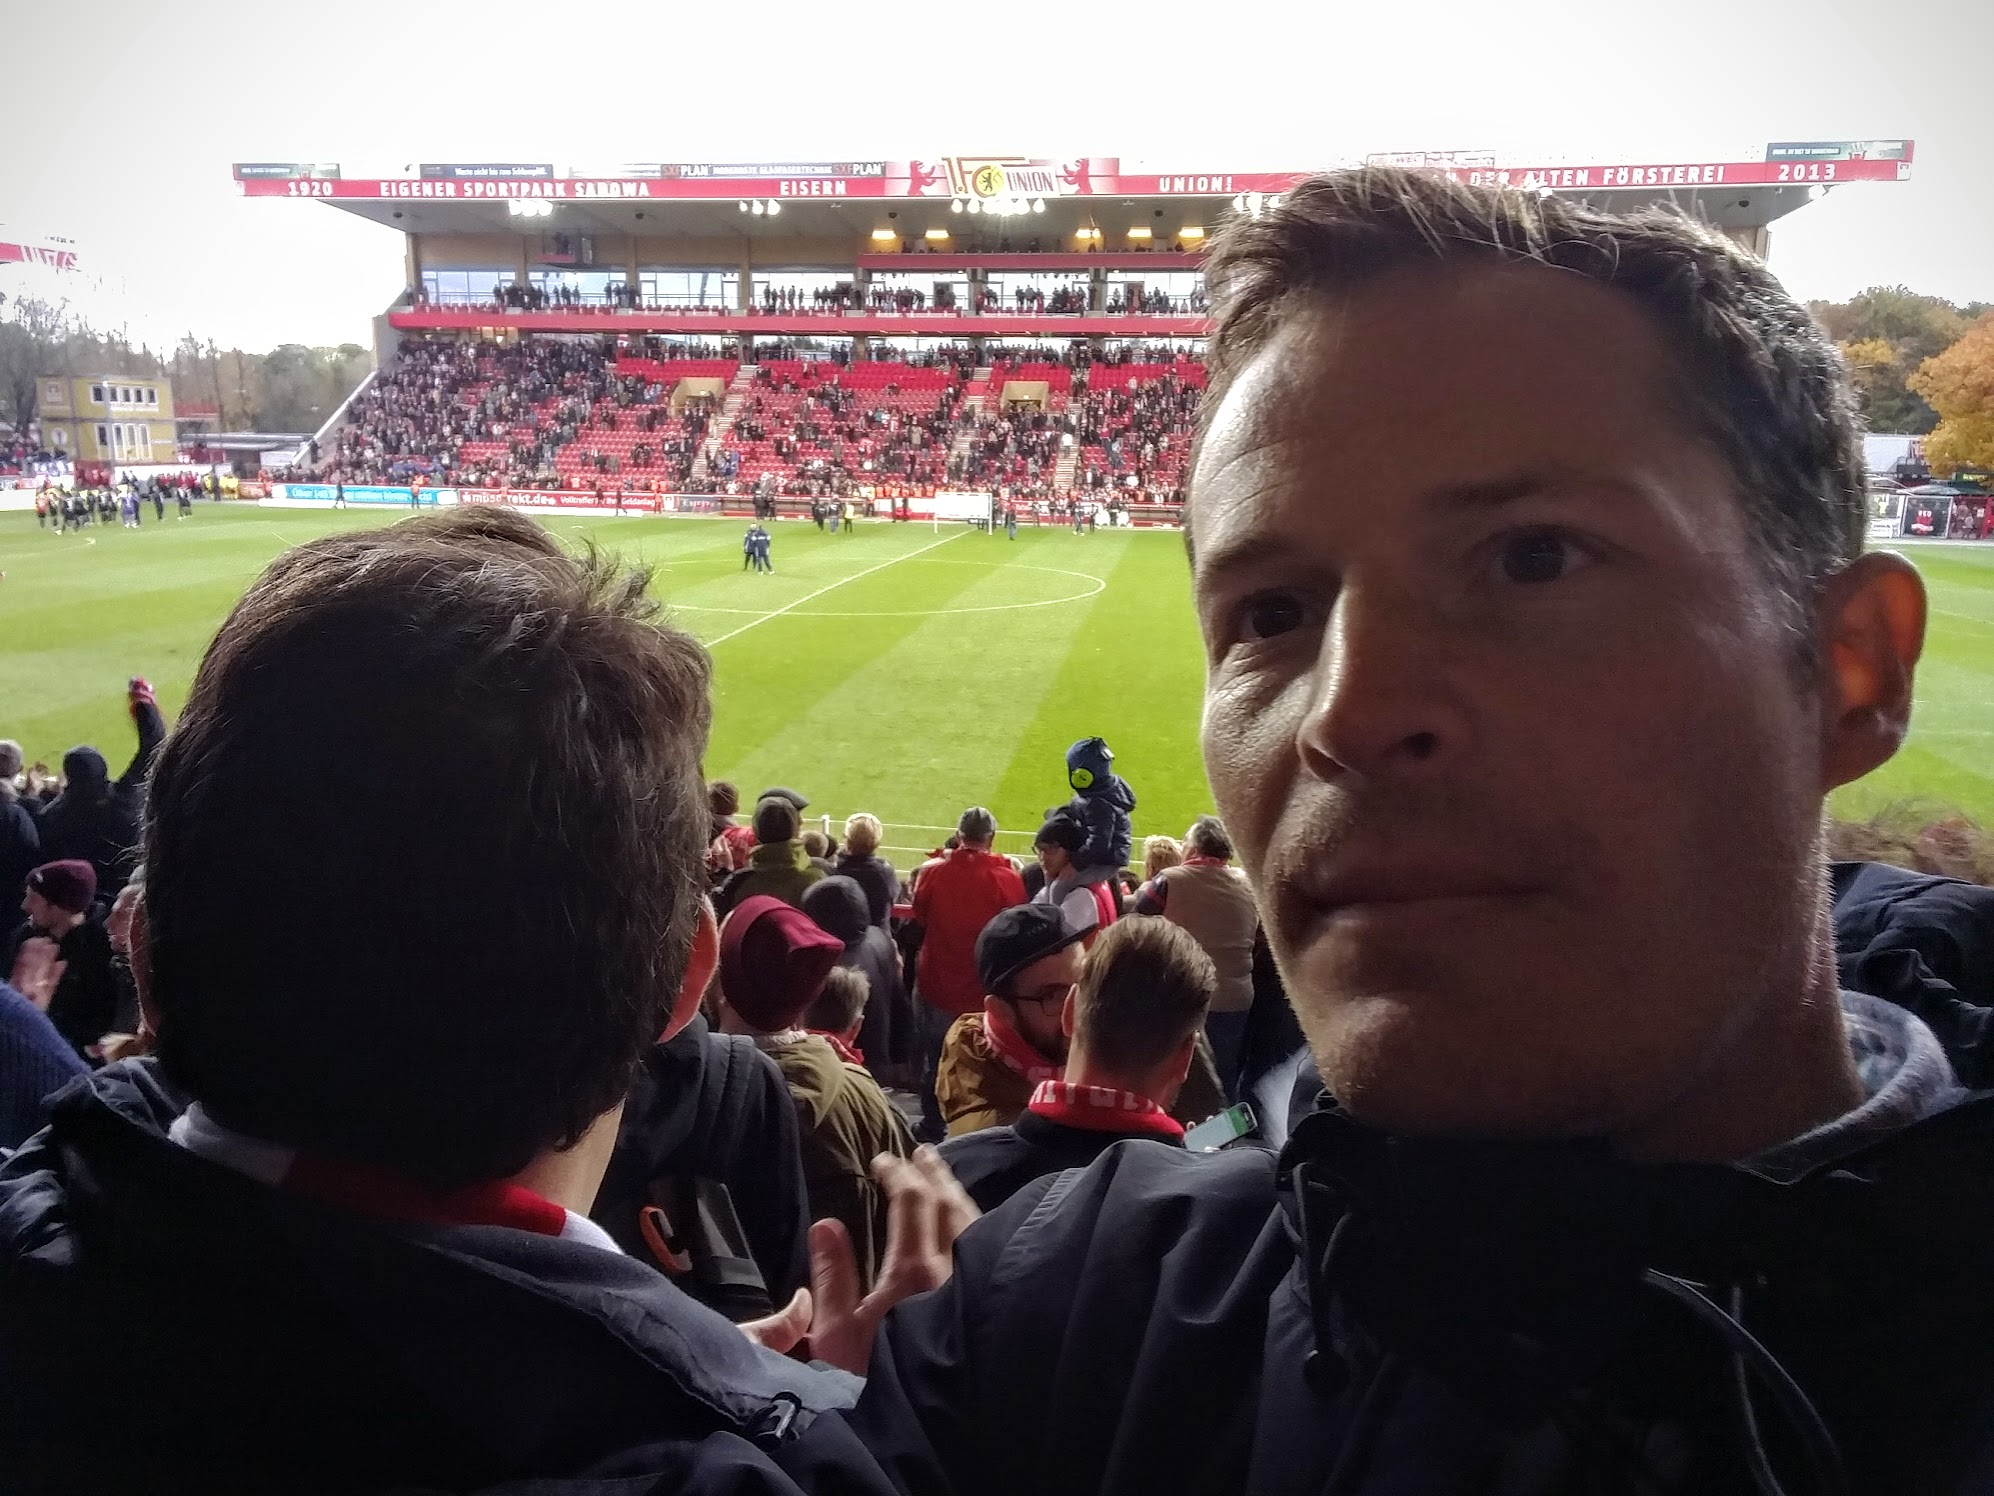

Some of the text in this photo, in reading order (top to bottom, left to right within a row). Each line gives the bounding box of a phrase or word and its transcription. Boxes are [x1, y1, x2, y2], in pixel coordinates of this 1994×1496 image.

[1523, 169, 1590, 187] ALTEN
[1603, 165, 1725, 185] FÖRSTEREI
[1778, 163, 1837, 181] 2013
[288, 181, 333, 197] 1920
[379, 181, 456, 197] EIGENER
[463, 181, 566, 198] SPORTPARK
[780, 176, 1233, 196] EISERN UNION!
[1006, 171, 1054, 192] UNION
[621, 497, 656, 507] Geldanlag
